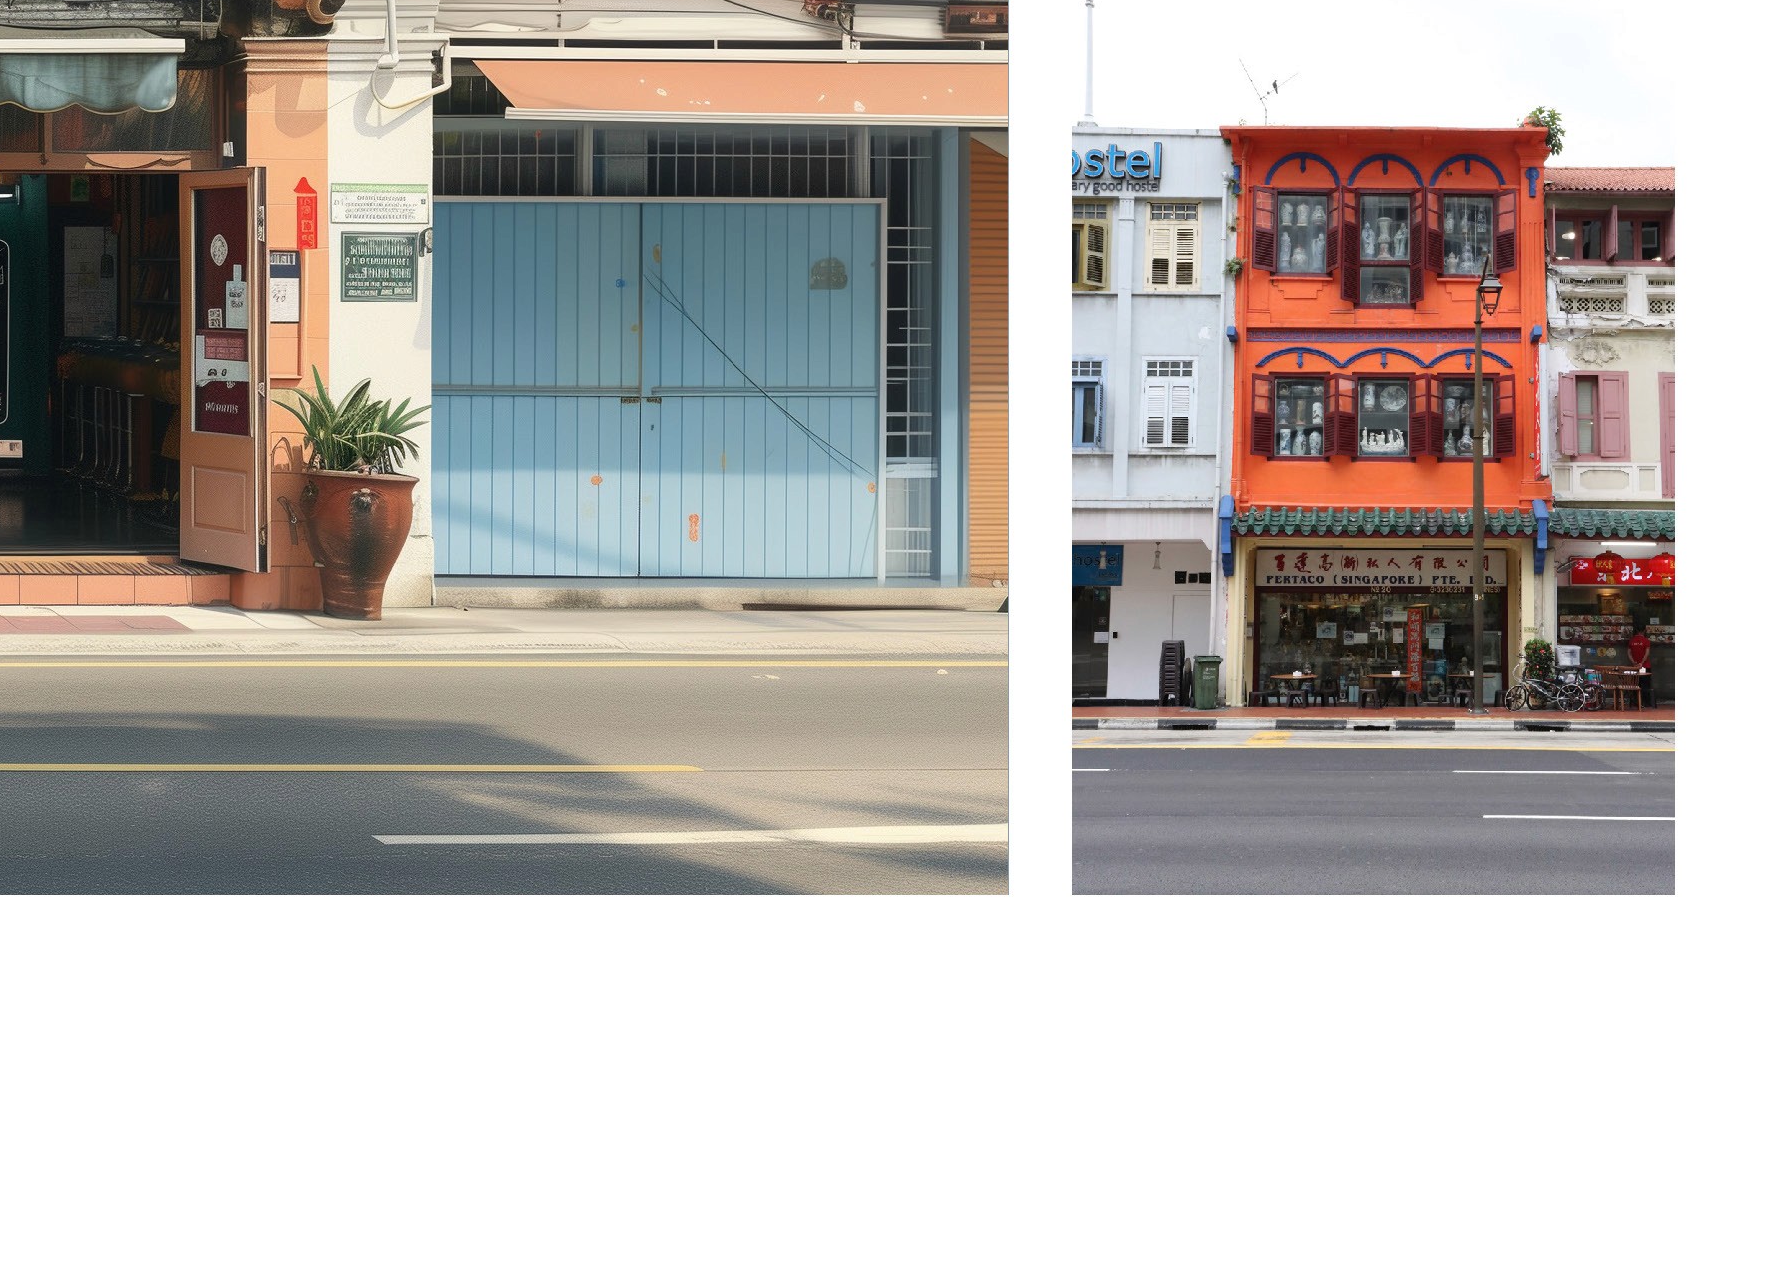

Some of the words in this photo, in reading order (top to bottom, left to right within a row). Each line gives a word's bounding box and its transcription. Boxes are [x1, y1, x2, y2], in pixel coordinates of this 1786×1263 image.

[1093, 180, 1123, 195] good
[1126, 179, 1160, 192] hostel
[1266, 575, 1325, 585] PERTACO
[1432, 575, 1460, 585] PTE.
